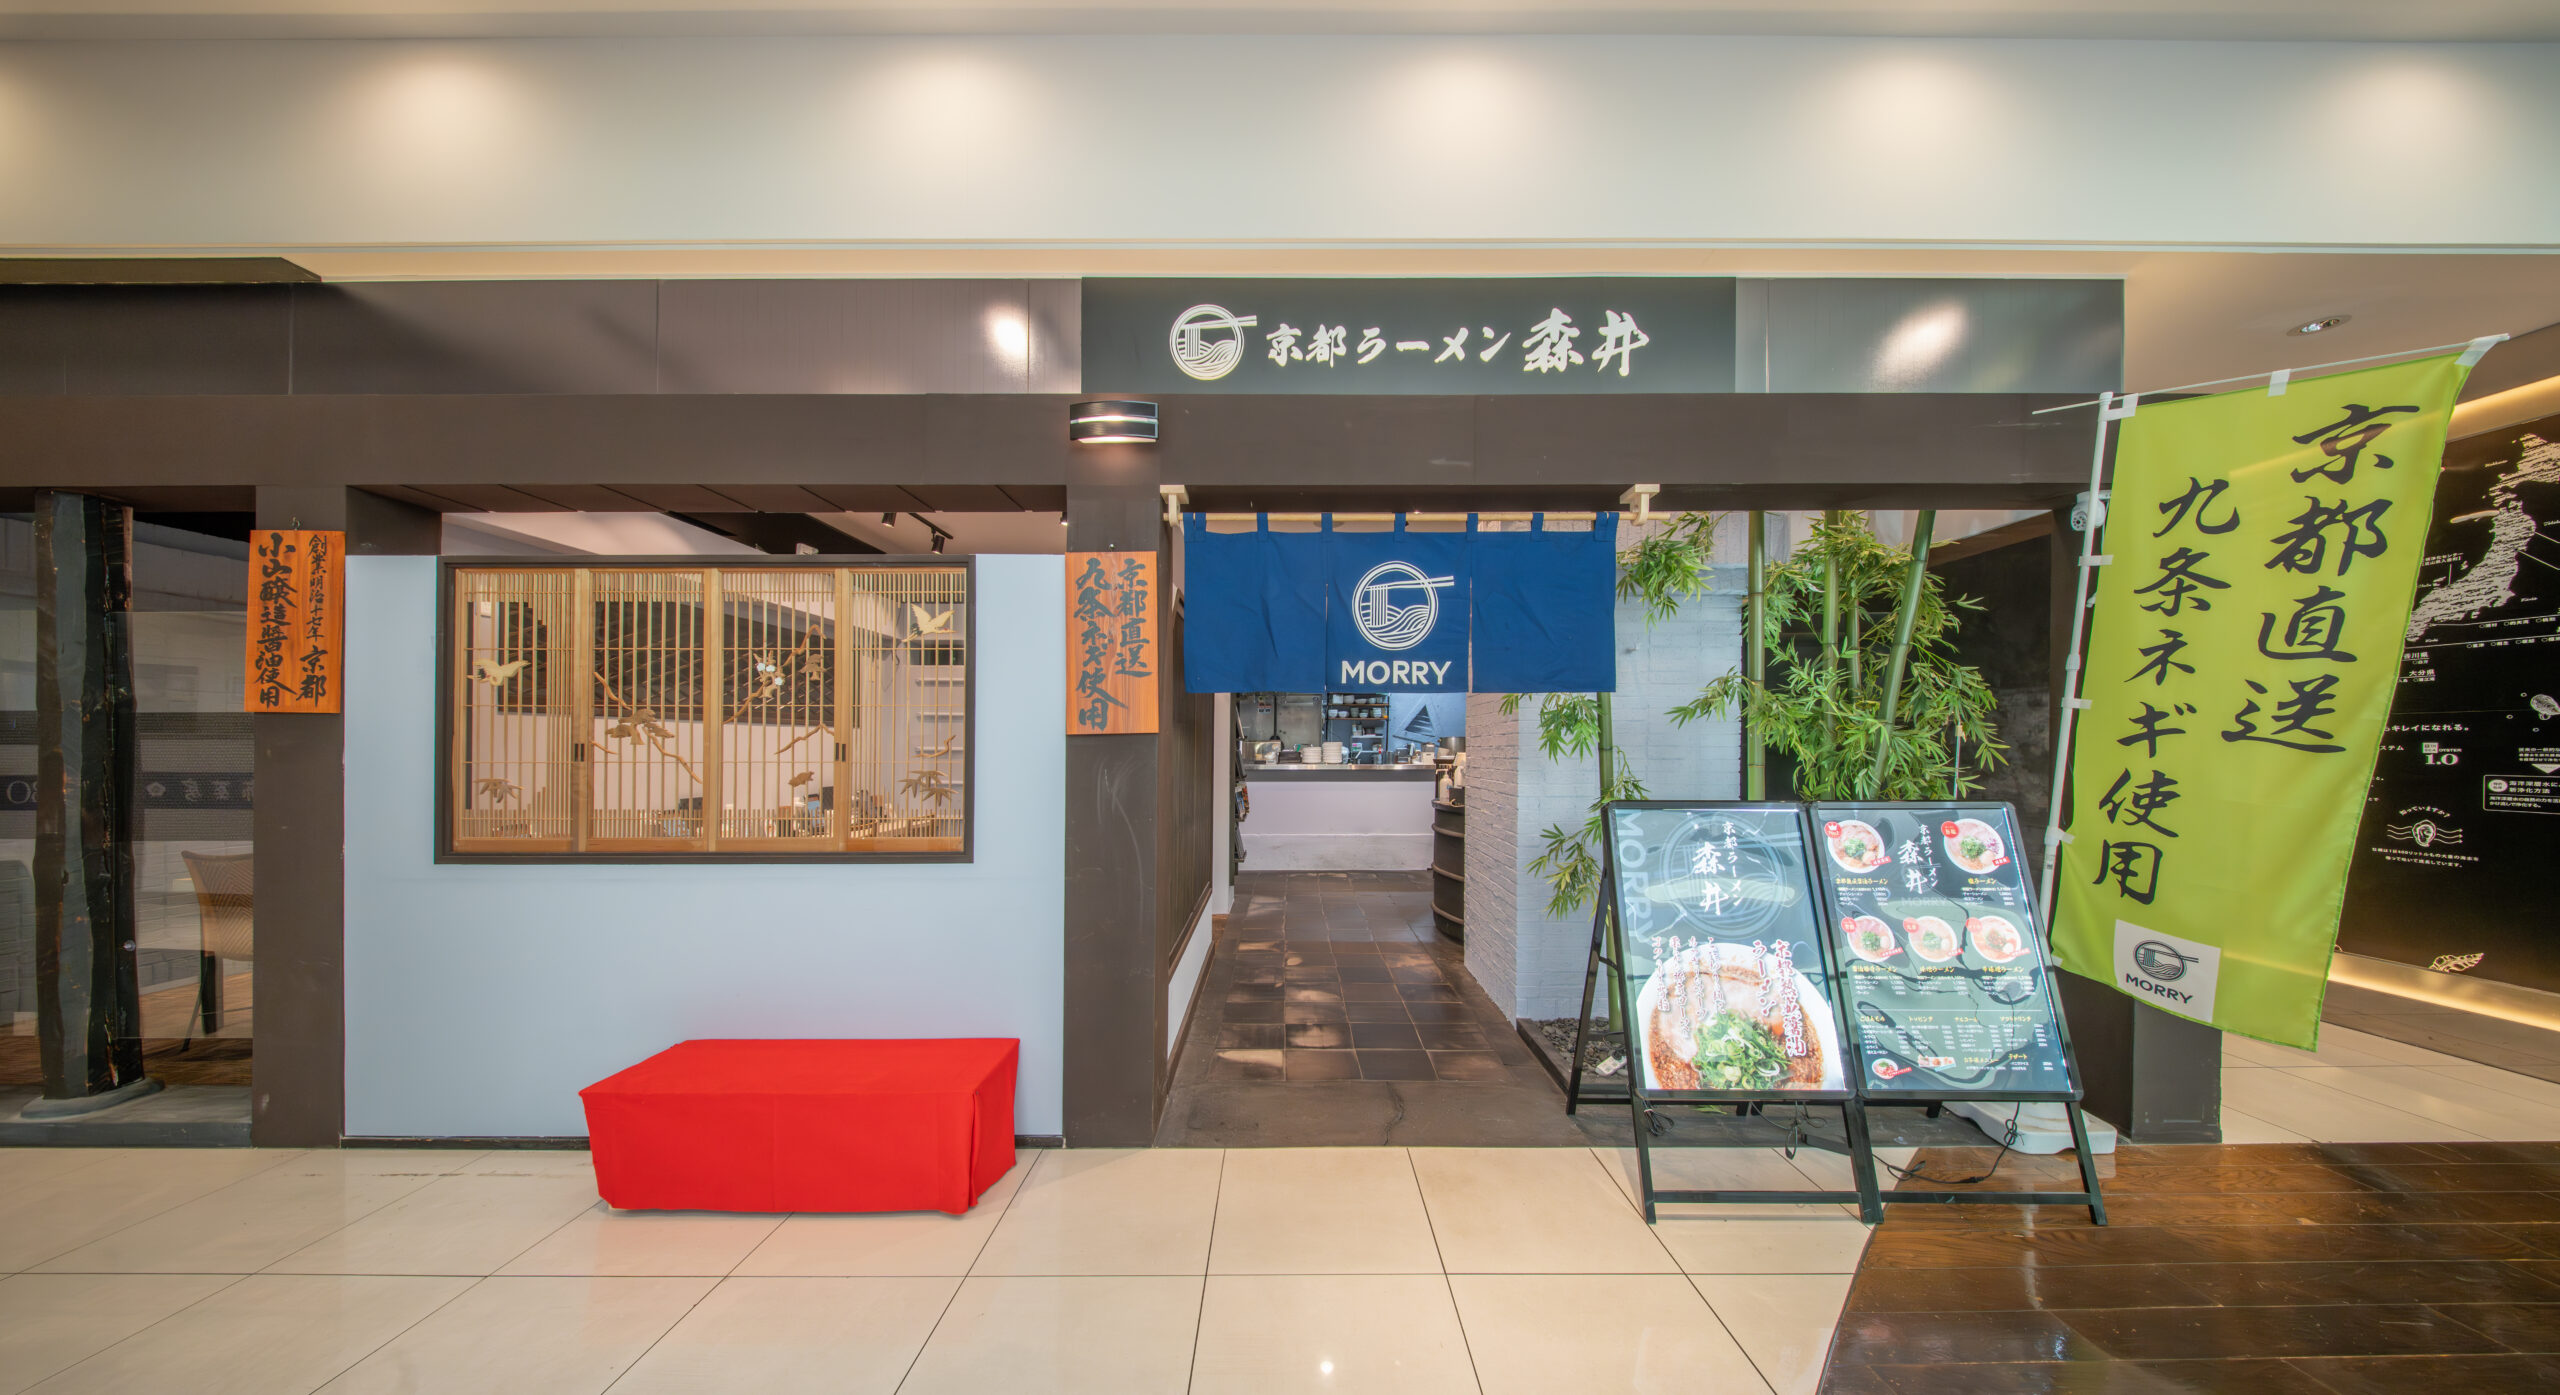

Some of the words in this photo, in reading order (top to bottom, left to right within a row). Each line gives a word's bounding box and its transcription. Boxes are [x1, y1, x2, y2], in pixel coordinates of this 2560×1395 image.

[1265, 323, 1512, 369] 京都ラーメン
[1522, 307, 1651, 378] 森井
[2221, 403, 2421, 754] 京都直送
[1073, 556, 1129, 733] 九条ネギ使用
[1115, 557, 1153, 679] 京都直送
[296, 645, 329, 708] 京都
[1340, 660, 1452, 686] MORRY
[2092, 476, 2242, 906] 九条ネギ使用
[2409, 668, 2435, 677] 大分県
[2425, 754, 2459, 766] 1.0
[1617, 811, 1654, 937] MORRY
[1692, 841, 1729, 916] 森井
[1721, 821, 1744, 906] 京都ラーメン
[1897, 839, 1929, 895] 森井
[1919, 823, 1938, 888] 京都ラーメン
[1752, 939, 1777, 1018] ラーメン
[2125, 972, 2194, 1005] MORRY
